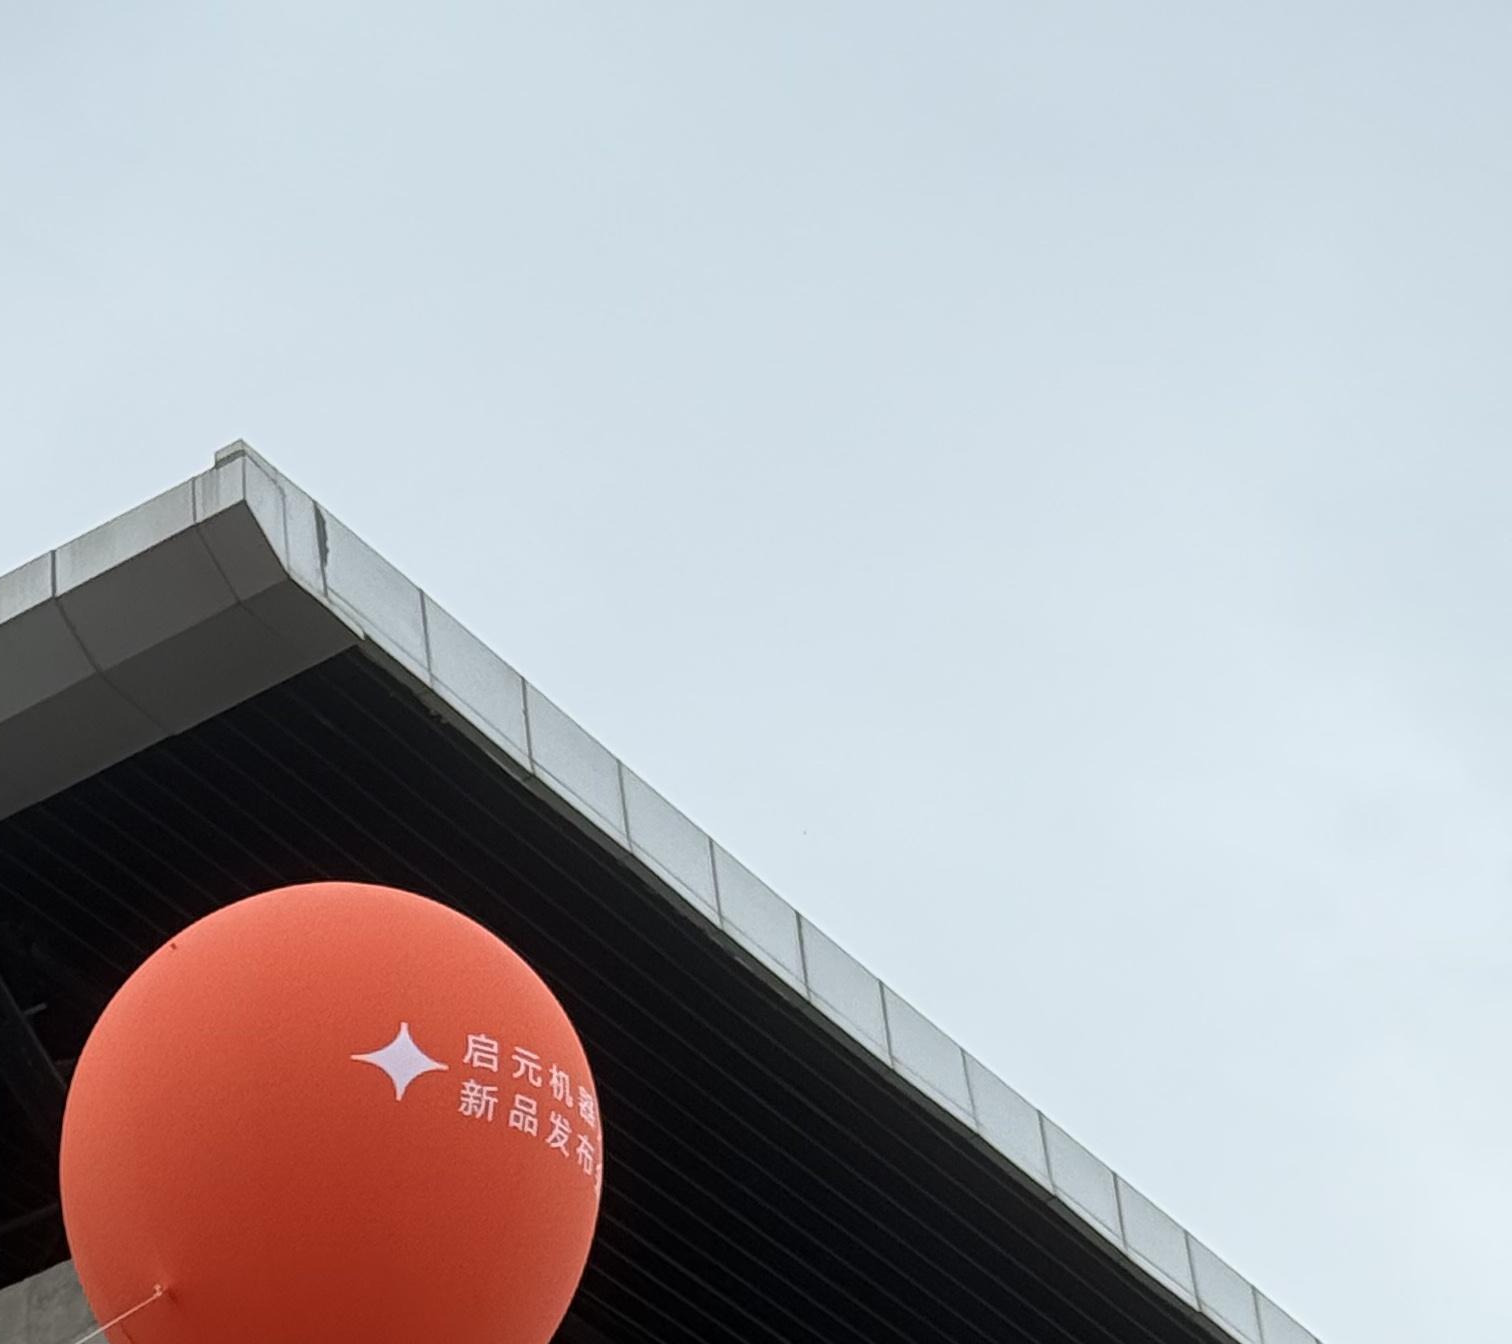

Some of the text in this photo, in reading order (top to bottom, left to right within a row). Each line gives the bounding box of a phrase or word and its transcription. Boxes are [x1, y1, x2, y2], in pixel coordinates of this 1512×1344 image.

[458, 1079, 602, 1196] 新品发布
[463, 1033, 602, 1141] 启元机器
